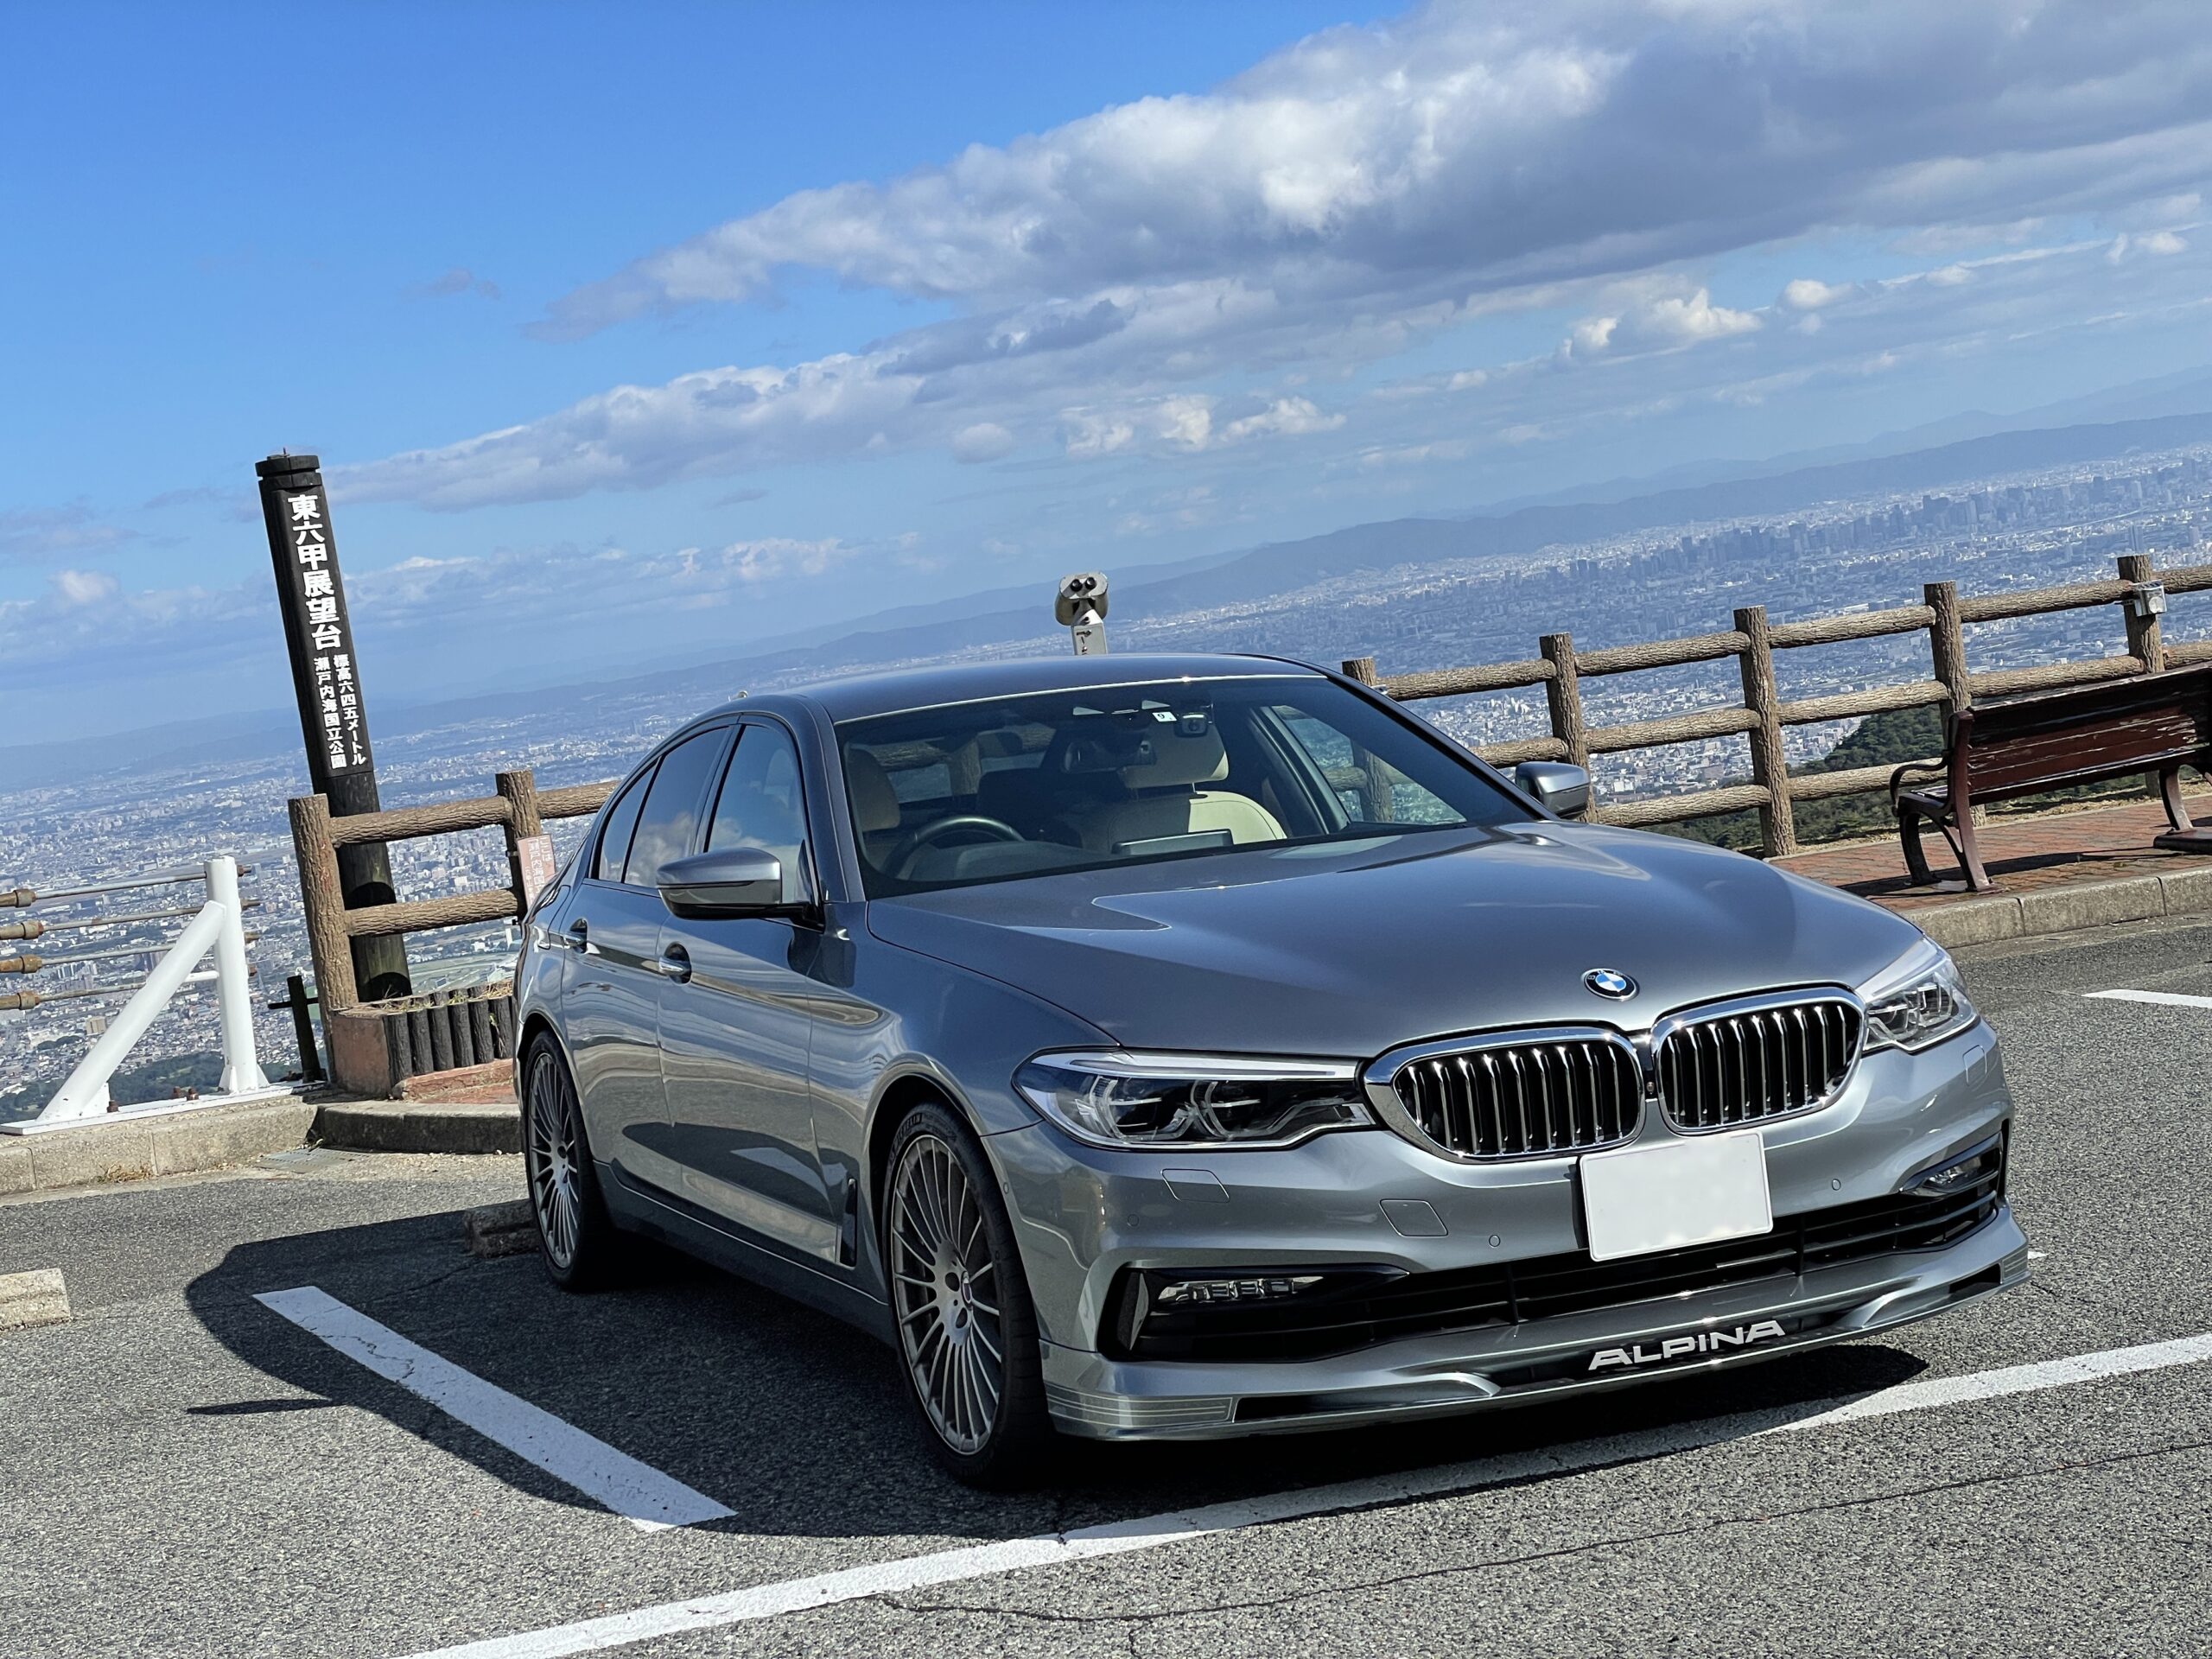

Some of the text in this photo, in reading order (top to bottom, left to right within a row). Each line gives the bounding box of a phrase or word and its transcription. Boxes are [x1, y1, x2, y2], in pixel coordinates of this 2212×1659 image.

[288, 494, 342, 650] 東六甲展望台
[314, 657, 347, 769] 瀬戸内海国立公園
[334, 654, 366, 766] 標高六四五メートル
[1588, 1320, 1785, 1370] ALPINA
